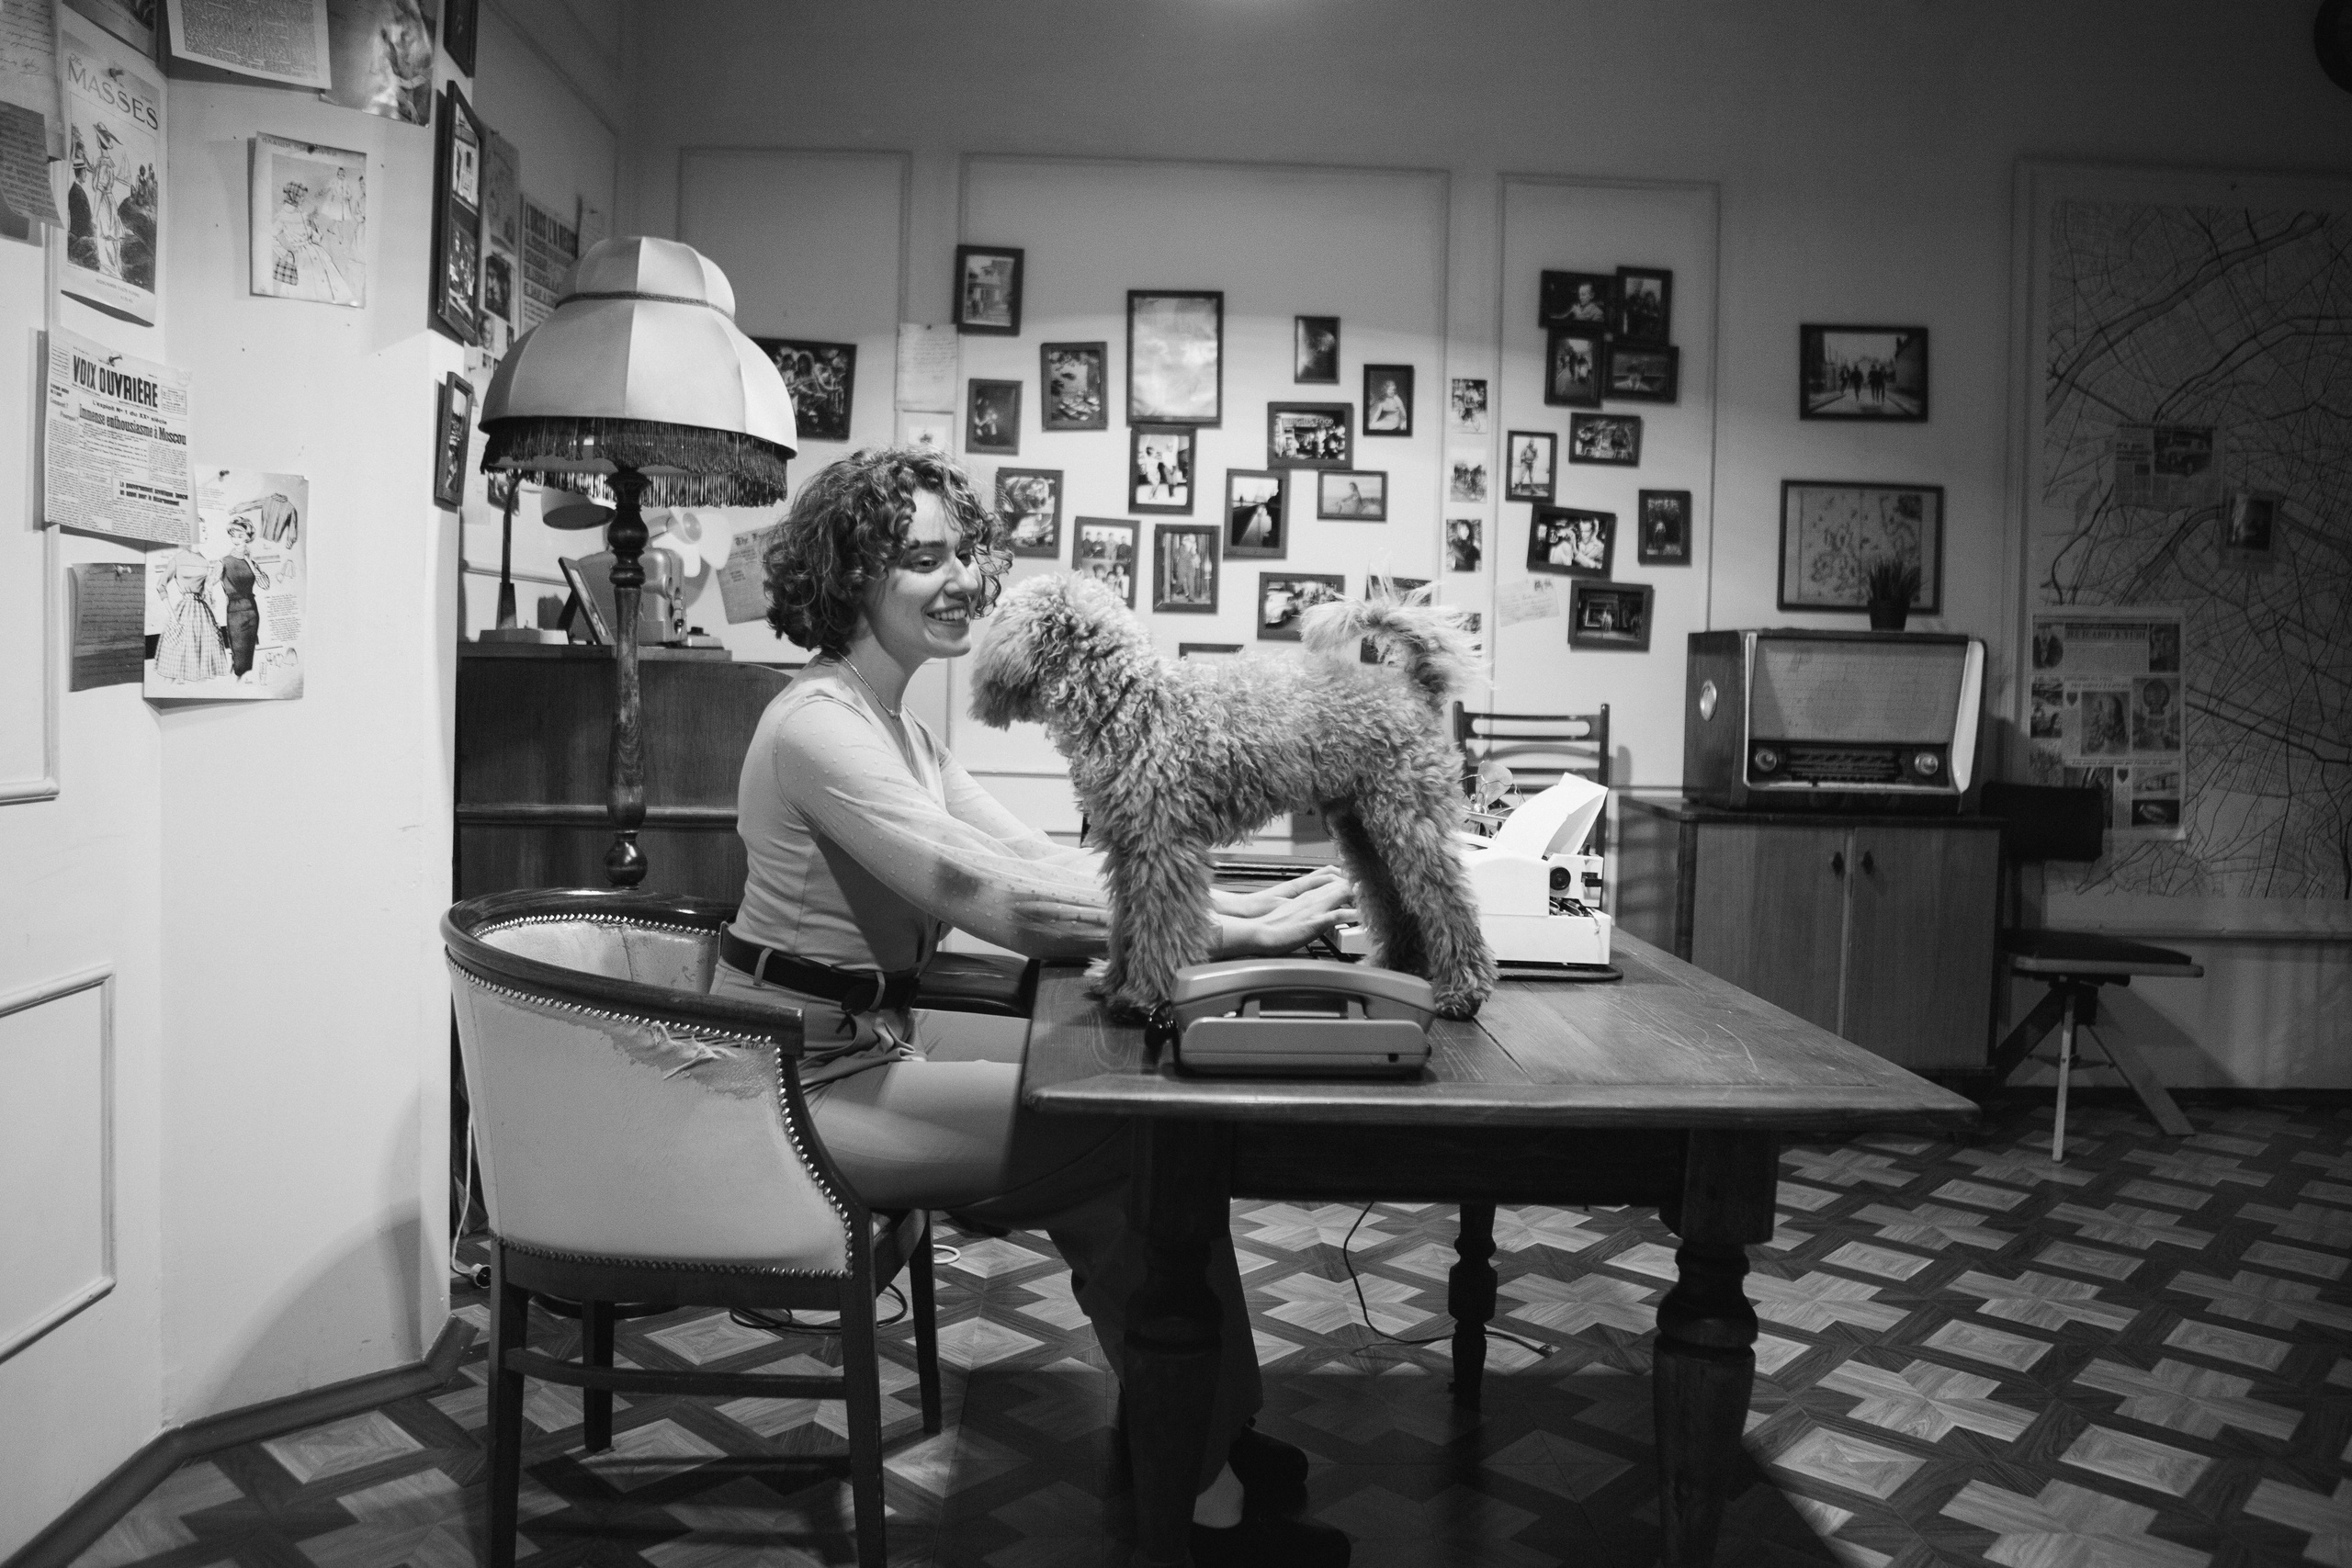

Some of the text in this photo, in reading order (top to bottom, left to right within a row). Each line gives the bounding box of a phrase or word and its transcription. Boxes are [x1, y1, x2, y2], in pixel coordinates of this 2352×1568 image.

[68, 56, 159, 130] MASSES
[74, 355, 96, 390] VOIX
[99, 367, 158, 408] OUVRIÈRE
[107, 413, 153, 438] enthousiasme
[159, 426, 187, 446] Moscou
